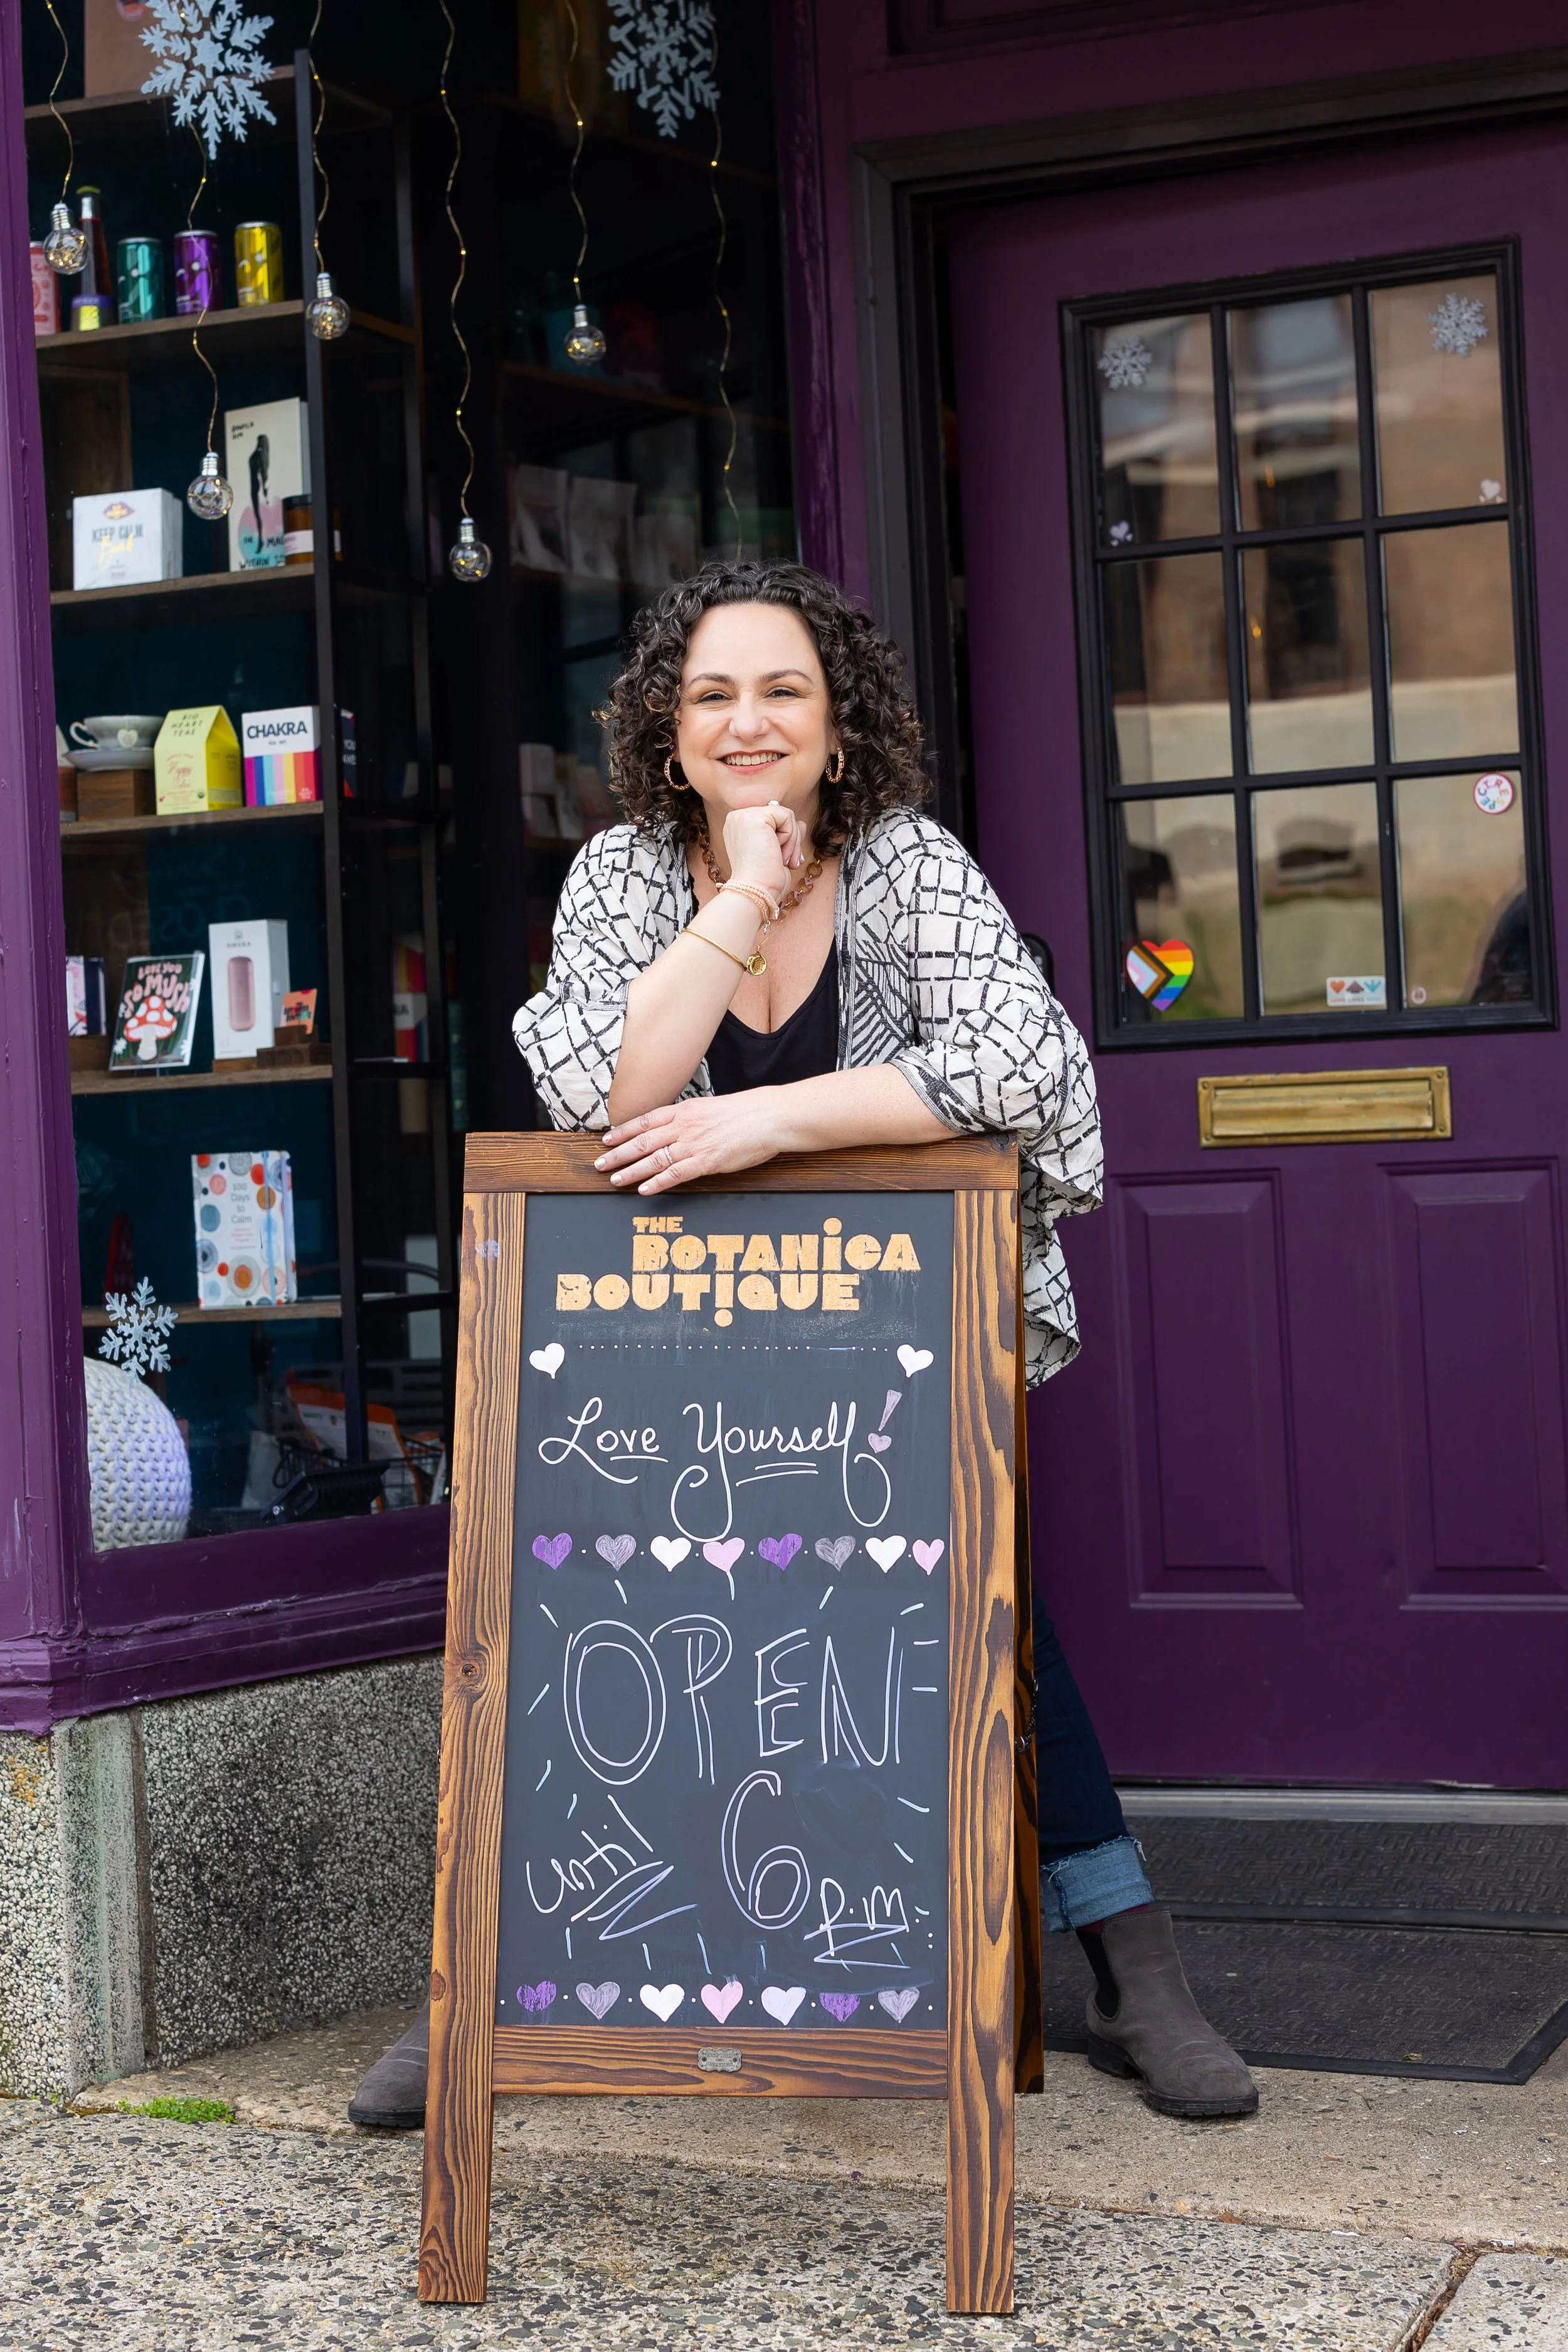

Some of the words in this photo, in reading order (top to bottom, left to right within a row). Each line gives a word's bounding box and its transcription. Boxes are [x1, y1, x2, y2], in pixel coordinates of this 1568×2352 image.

[247, 721, 307, 739] CHAKRA
[230, 1193, 250, 1202] Days
[230, 1215, 252, 1224] Calm
[632, 1216, 683, 1233] THE
[538, 1397, 660, 1485] Love
[563, 1614, 904, 1785] OPEN
[720, 1770, 811, 1930] 6
